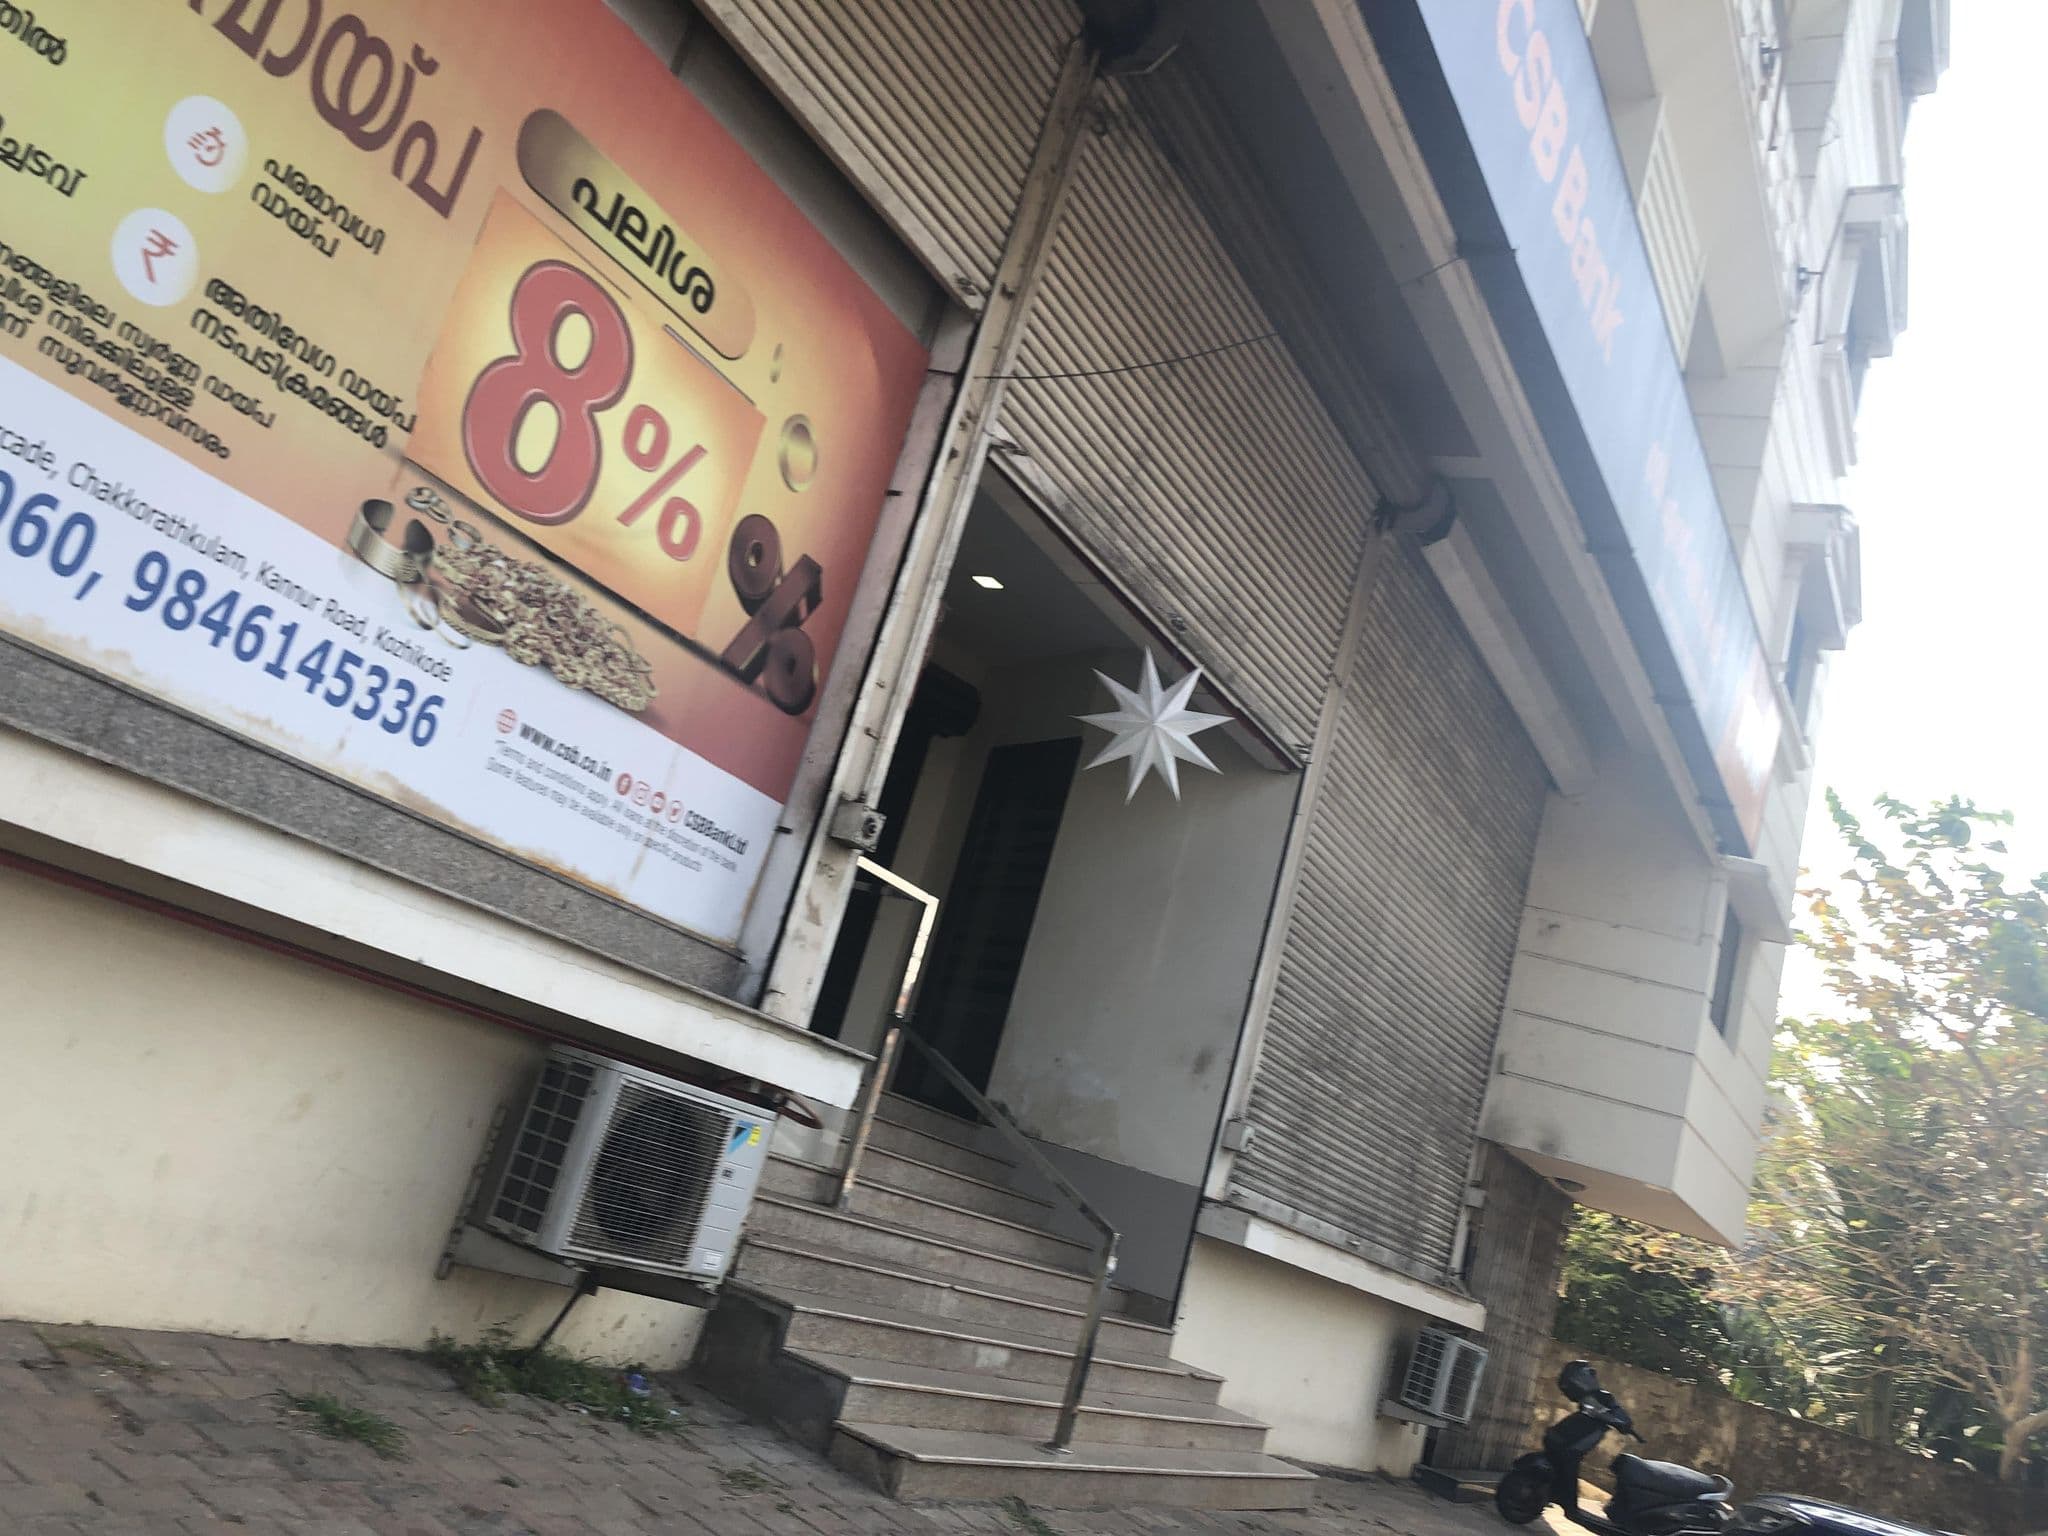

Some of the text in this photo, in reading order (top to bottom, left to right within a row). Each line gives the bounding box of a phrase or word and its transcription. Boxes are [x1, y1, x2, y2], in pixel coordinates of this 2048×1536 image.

[250, 181, 340, 259] വായ്പ
[264, 158, 387, 257] പരമാവധി
[571, 177, 715, 314] പലിശ
[1552, 143, 1624, 363] Bank
[202, 375, 276, 429] വായ്പ
[205, 277, 418, 435] അതിവേഗ വായ്പ
[123, 549, 446, 748] 9846145336
[256, 560, 323, 610] Kannur
[321, 598, 369, 642] Road,
[373, 626, 455, 683] Kozhikode
